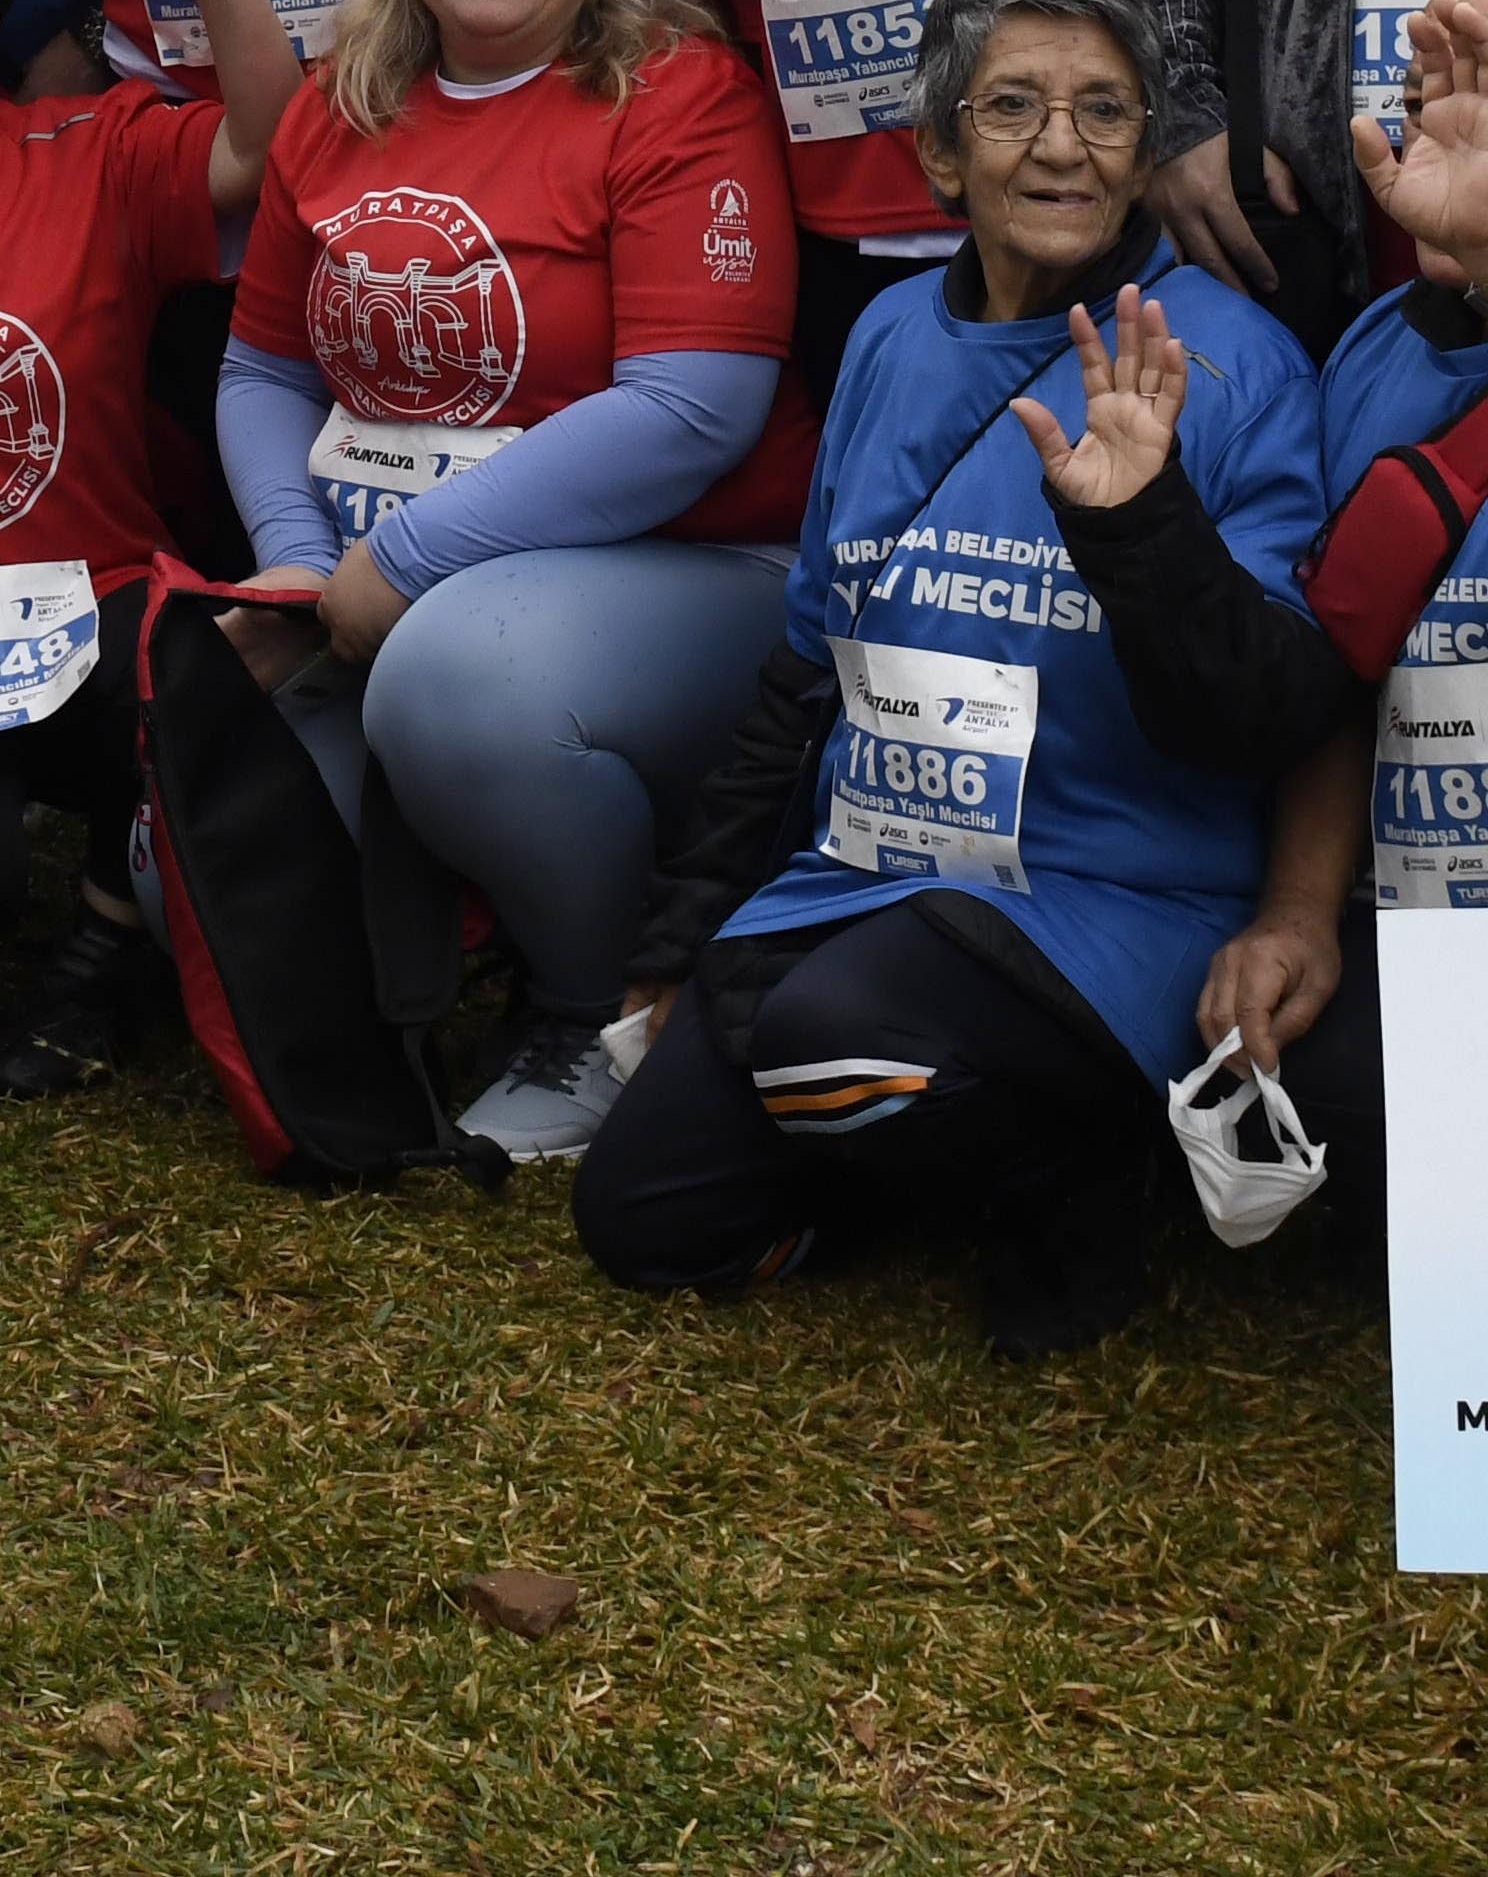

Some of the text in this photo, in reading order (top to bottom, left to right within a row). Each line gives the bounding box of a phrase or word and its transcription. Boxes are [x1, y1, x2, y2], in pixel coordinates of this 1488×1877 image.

[788, 66, 850, 87] Muratpaşa
[326, 197, 477, 254] MURATPAŞA
[713, 217, 746, 226] ANTALYA
[704, 228, 752, 258] Ümit
[344, 444, 415, 471] RUNTALYA
[967, 699, 1008, 712] PRESENTED
[964, 716, 1010, 729] ANTALYA
[849, 731, 987, 805] 11886
[899, 797, 934, 821] Yaşlı
[939, 805, 997, 830] Meclisi
